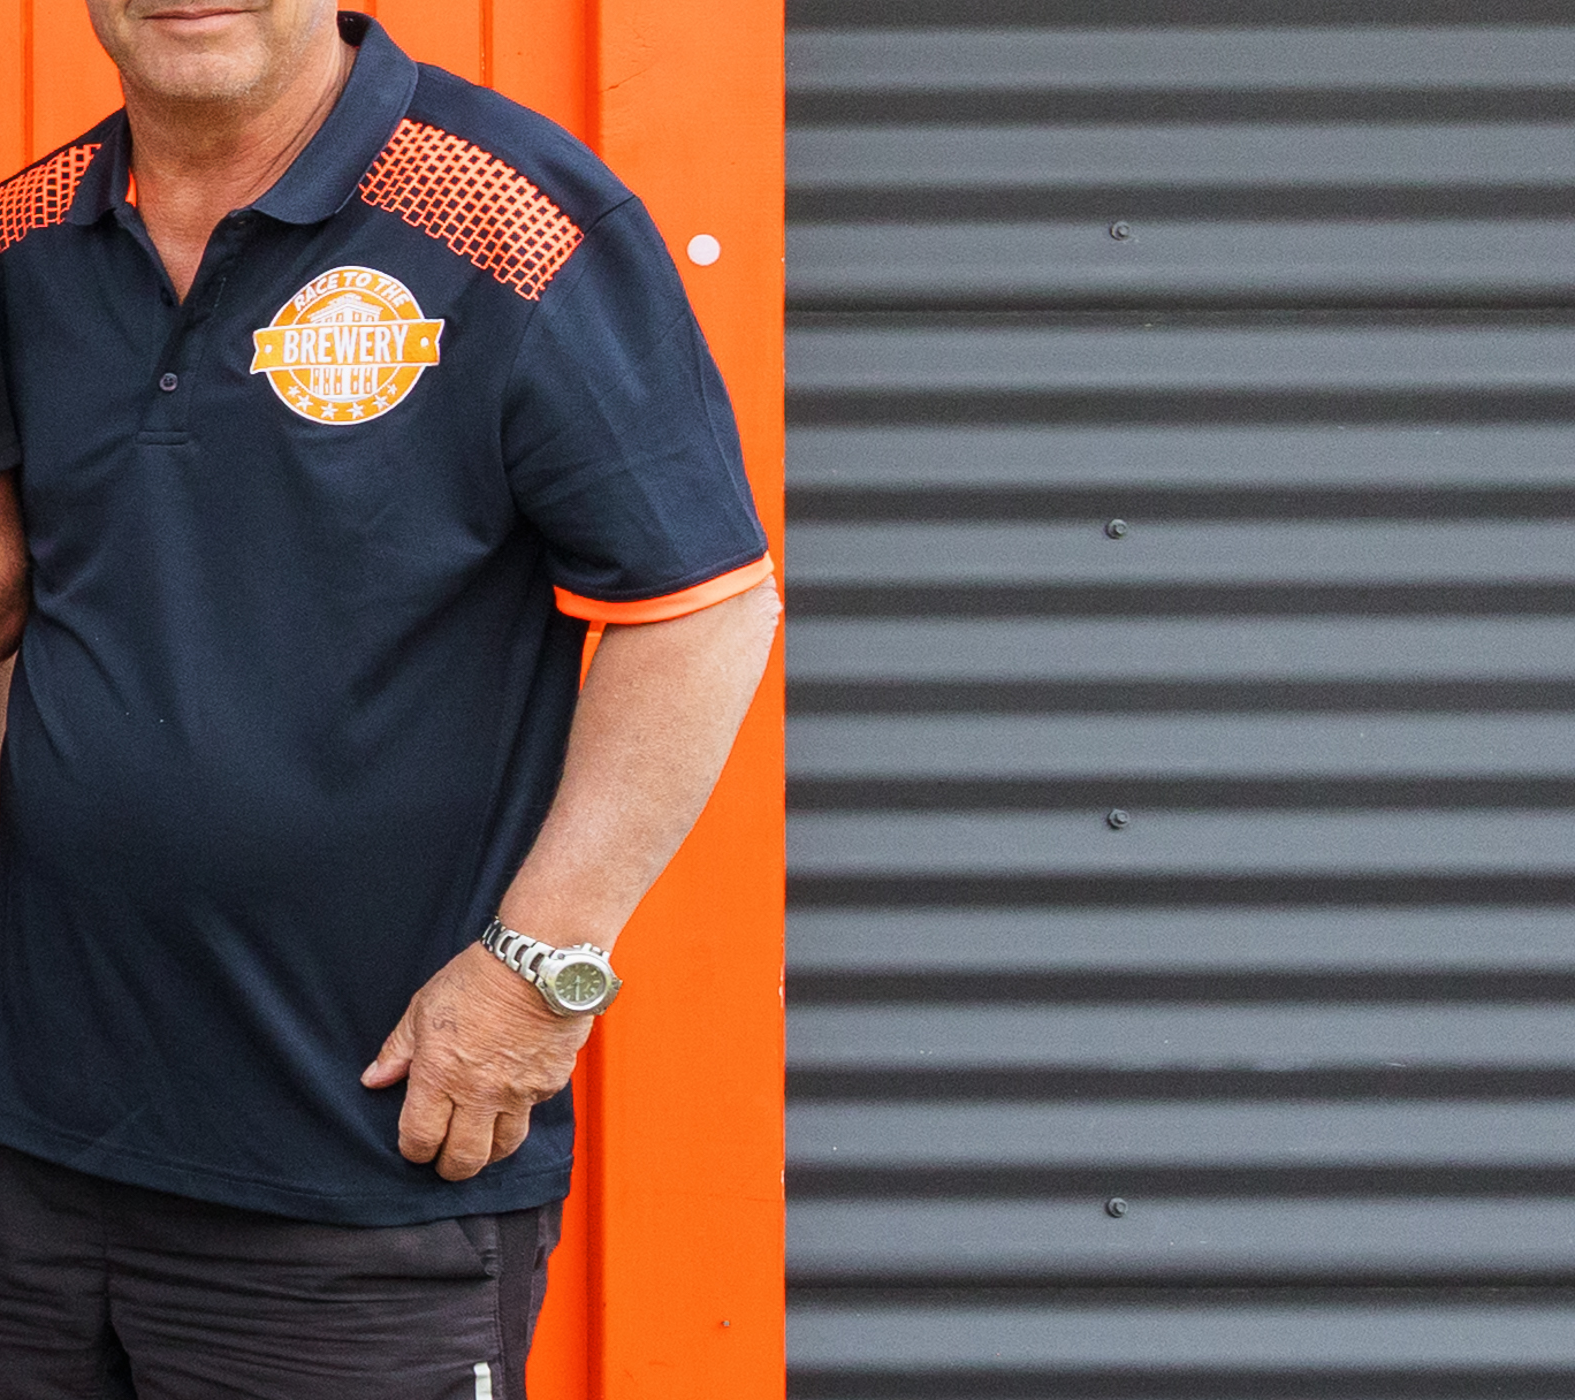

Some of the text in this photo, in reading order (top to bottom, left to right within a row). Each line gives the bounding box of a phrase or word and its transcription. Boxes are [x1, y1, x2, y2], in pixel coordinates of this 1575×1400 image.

[293, 271, 412, 312] RACE TO THE
[283, 324, 409, 364] BREWERY
